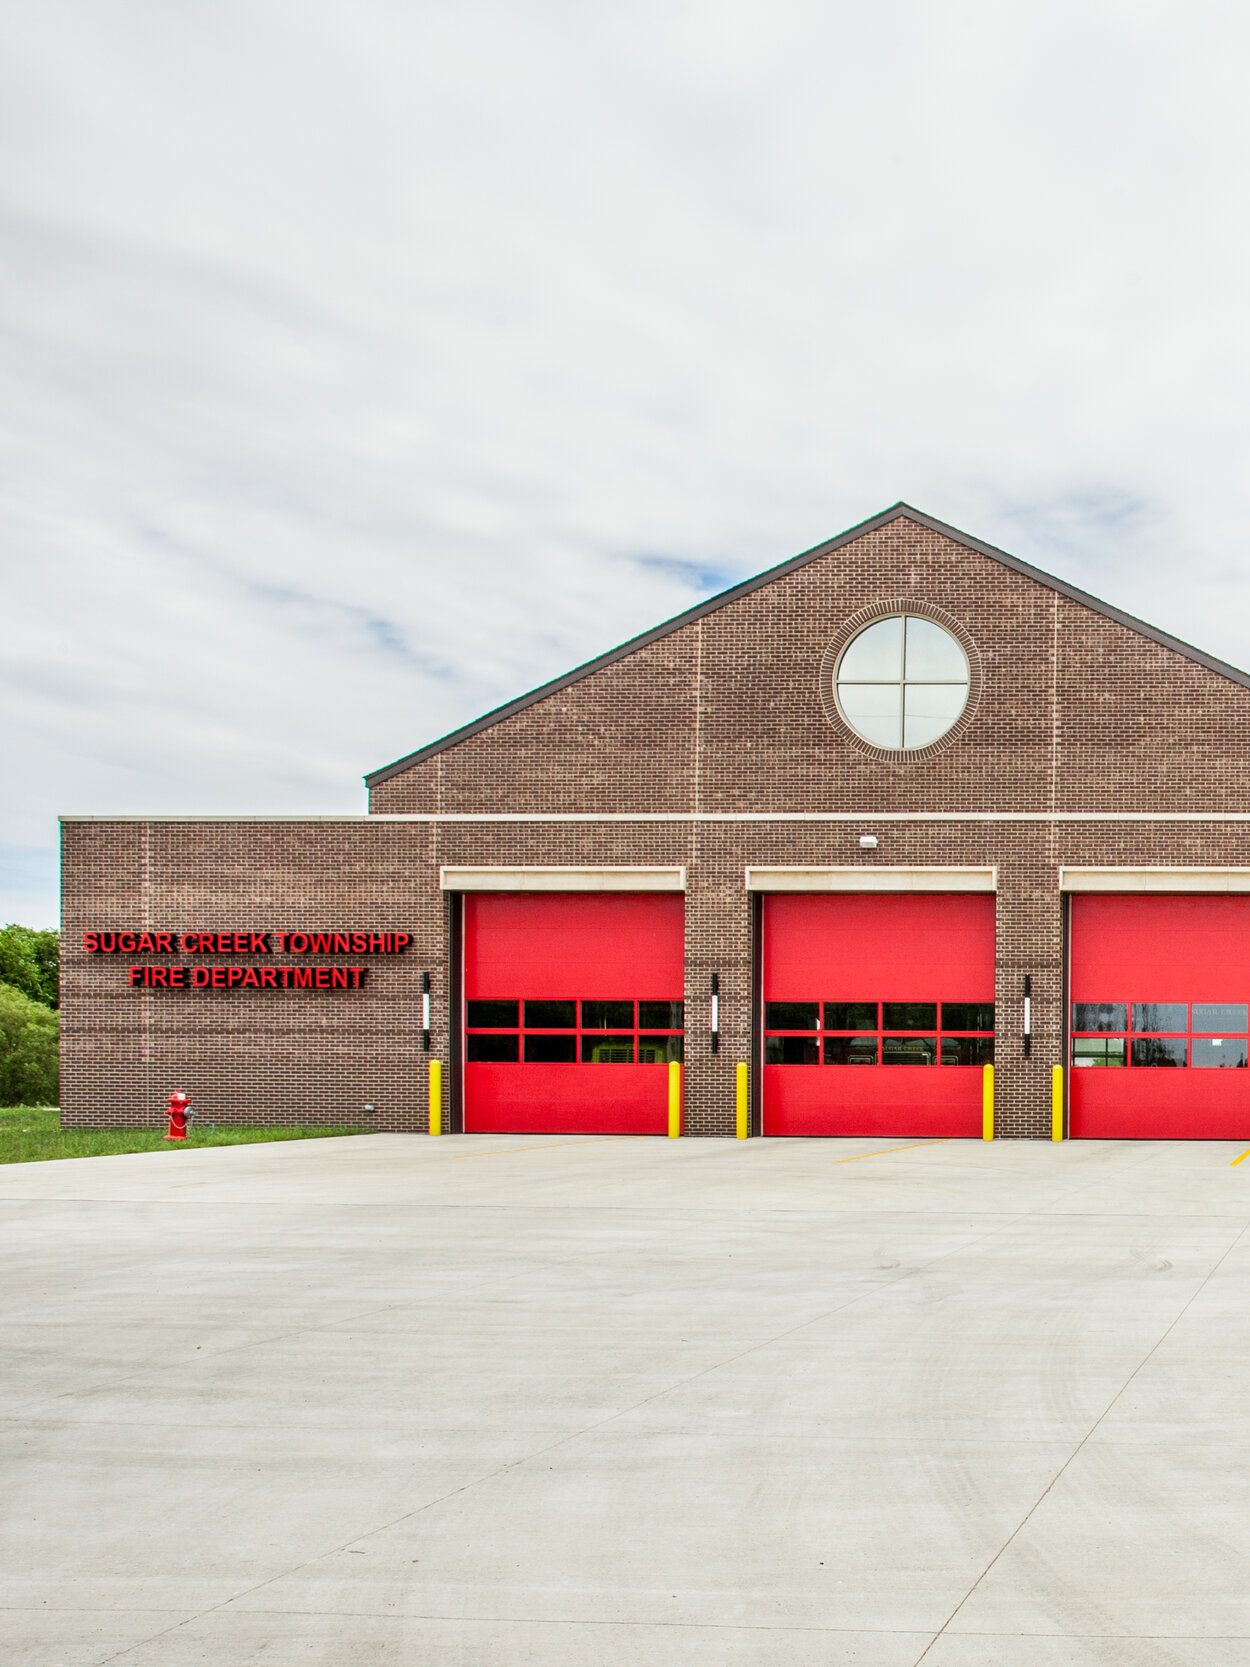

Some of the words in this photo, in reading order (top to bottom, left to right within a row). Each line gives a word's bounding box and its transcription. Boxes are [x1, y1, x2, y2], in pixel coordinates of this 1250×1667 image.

[83, 932, 173, 953] SUGAR
[181, 932, 268, 953] CREEK
[275, 932, 411, 953] TOWNSHIP
[129, 967, 184, 987] FIRE
[193, 967, 366, 988] DEPARTMENT
